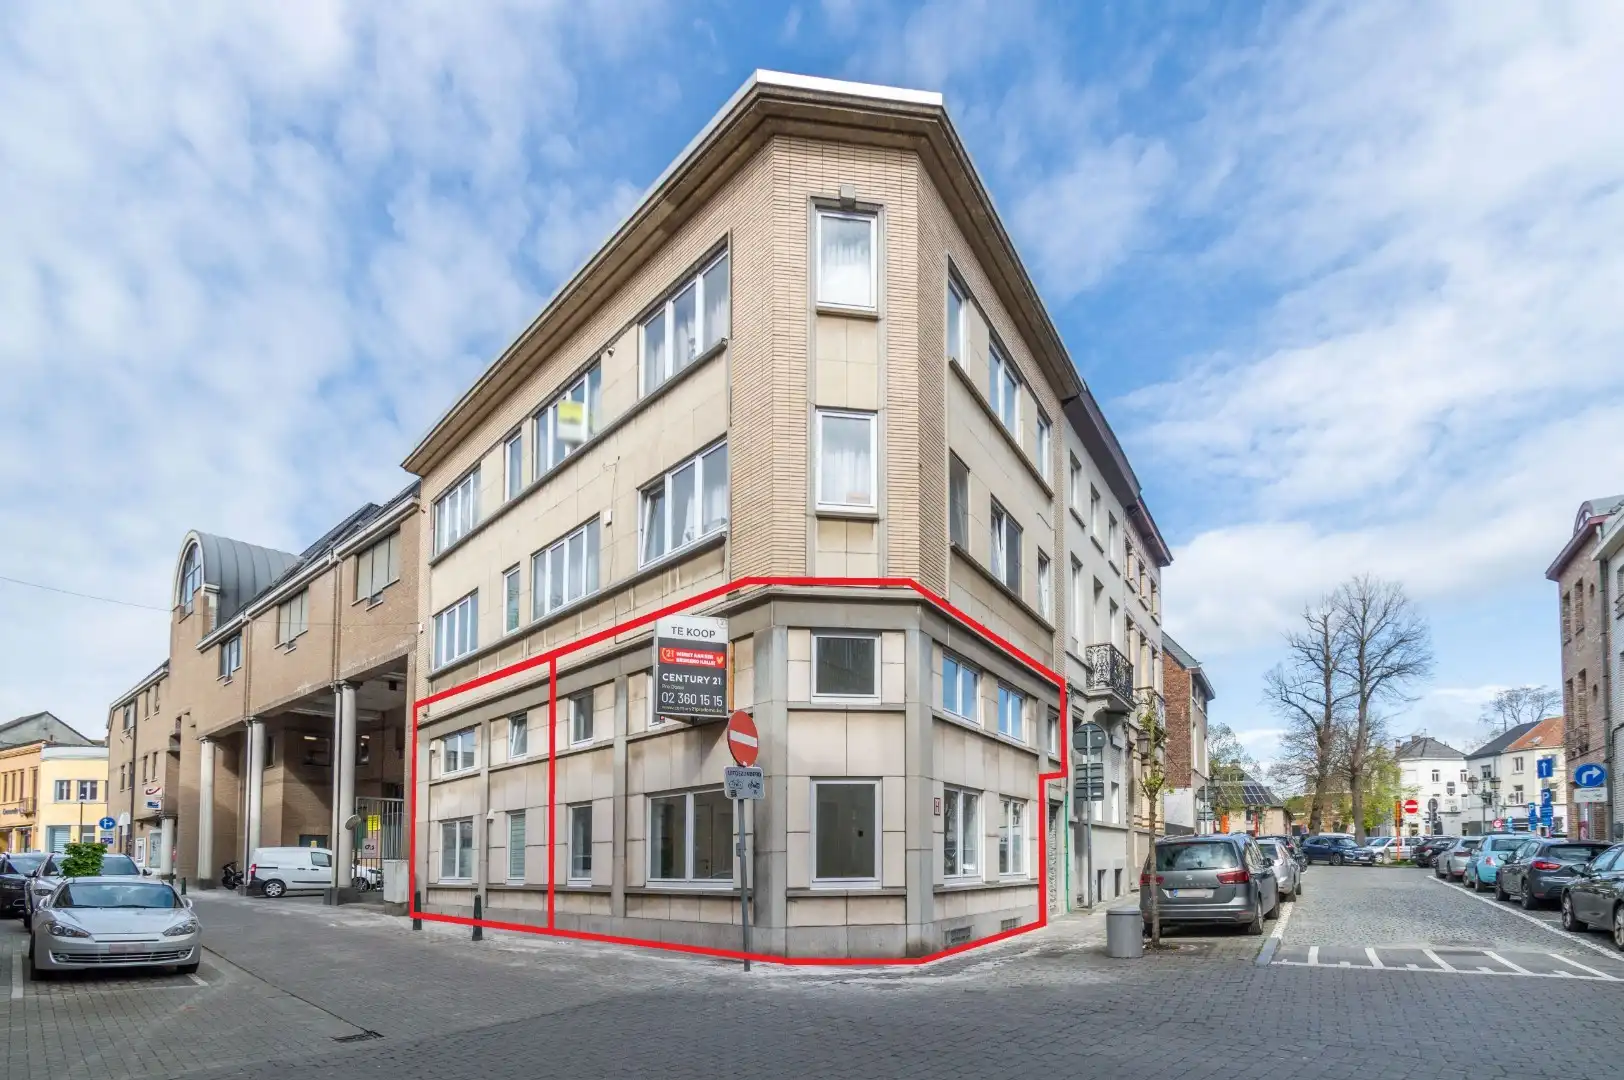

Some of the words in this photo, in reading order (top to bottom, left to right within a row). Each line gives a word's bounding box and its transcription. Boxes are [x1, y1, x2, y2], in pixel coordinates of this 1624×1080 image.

[671, 626, 684, 636] TE
[686, 628, 716, 639] KOOP
[662, 673, 711, 685] CENTURY
[712, 676, 722, 685] 21
[661, 691, 675, 704] 02
[677, 692, 697, 705] 360
[699, 694, 711, 706] 15
[712, 695, 723, 707] 15
[1542, 791, 1550, 804] P
